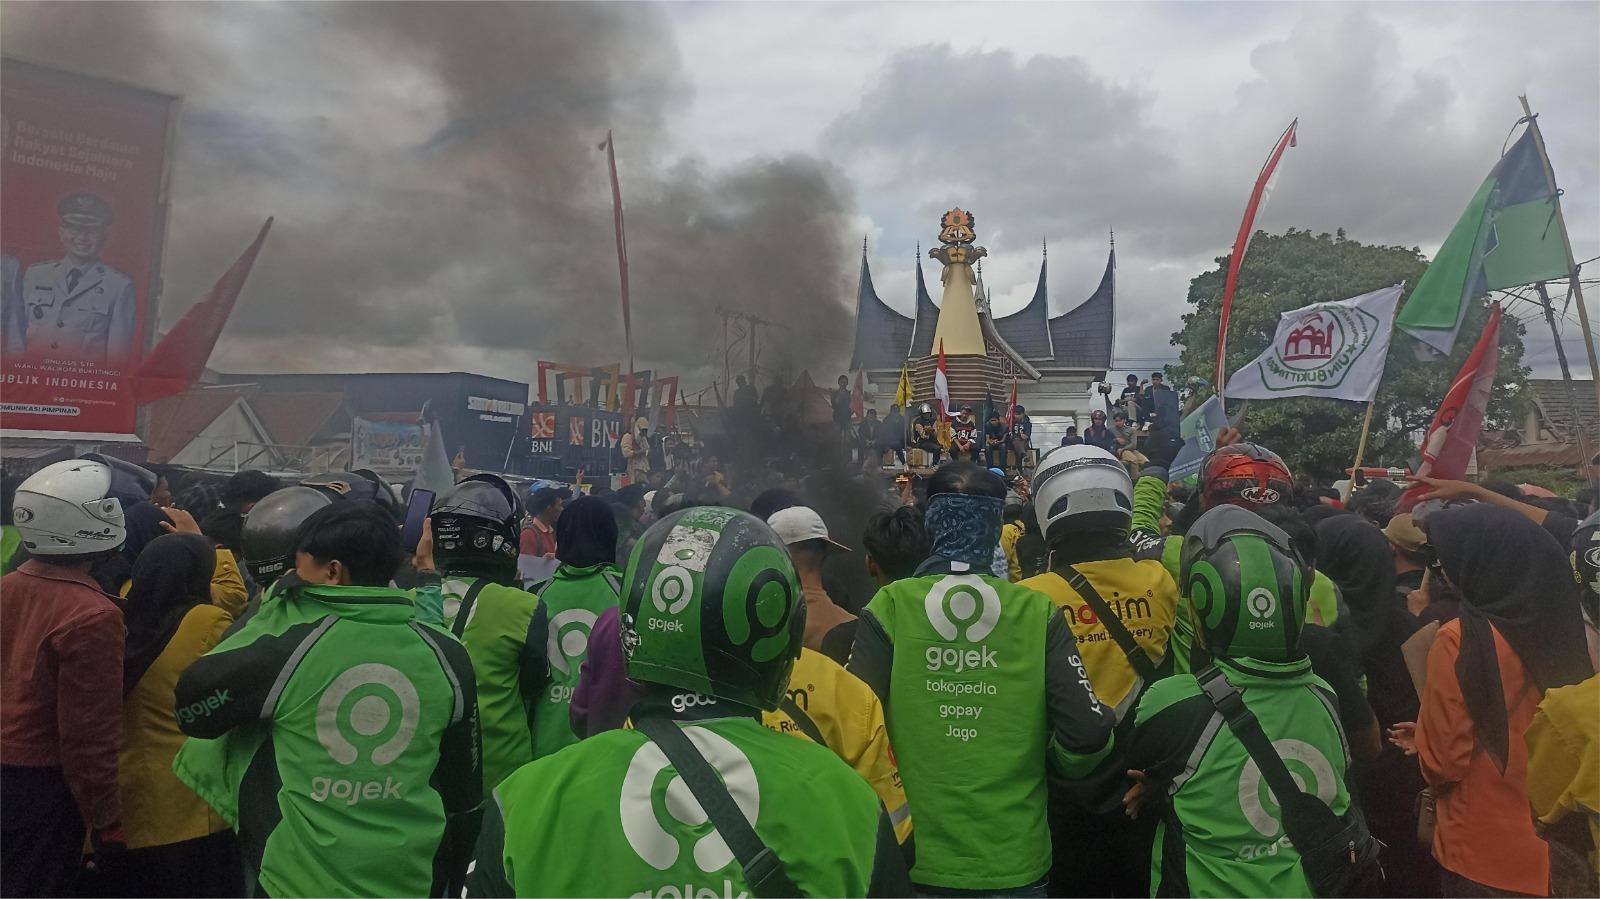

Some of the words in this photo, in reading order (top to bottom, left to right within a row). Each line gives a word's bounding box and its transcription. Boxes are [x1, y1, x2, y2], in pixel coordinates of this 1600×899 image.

[12, 151, 82, 175] Indonesia
[85, 165, 118, 182] Maju
[45, 377, 118, 391] INDONESIA
[41, 406, 78, 414] PIMPINAN
[531, 440, 553, 453] BNI
[648, 618, 684, 632] gojek
[1249, 621, 1275, 630] gojek
[1087, 631, 1107, 643] and
[925, 646, 998, 673] gojek
[926, 680, 997, 697] tokopedia
[1068, 654, 1104, 716] gopay
[178, 688, 232, 724] gojek
[939, 703, 983, 718] gopay
[945, 725, 978, 742] Jago
[310, 776, 403, 805] gojek
